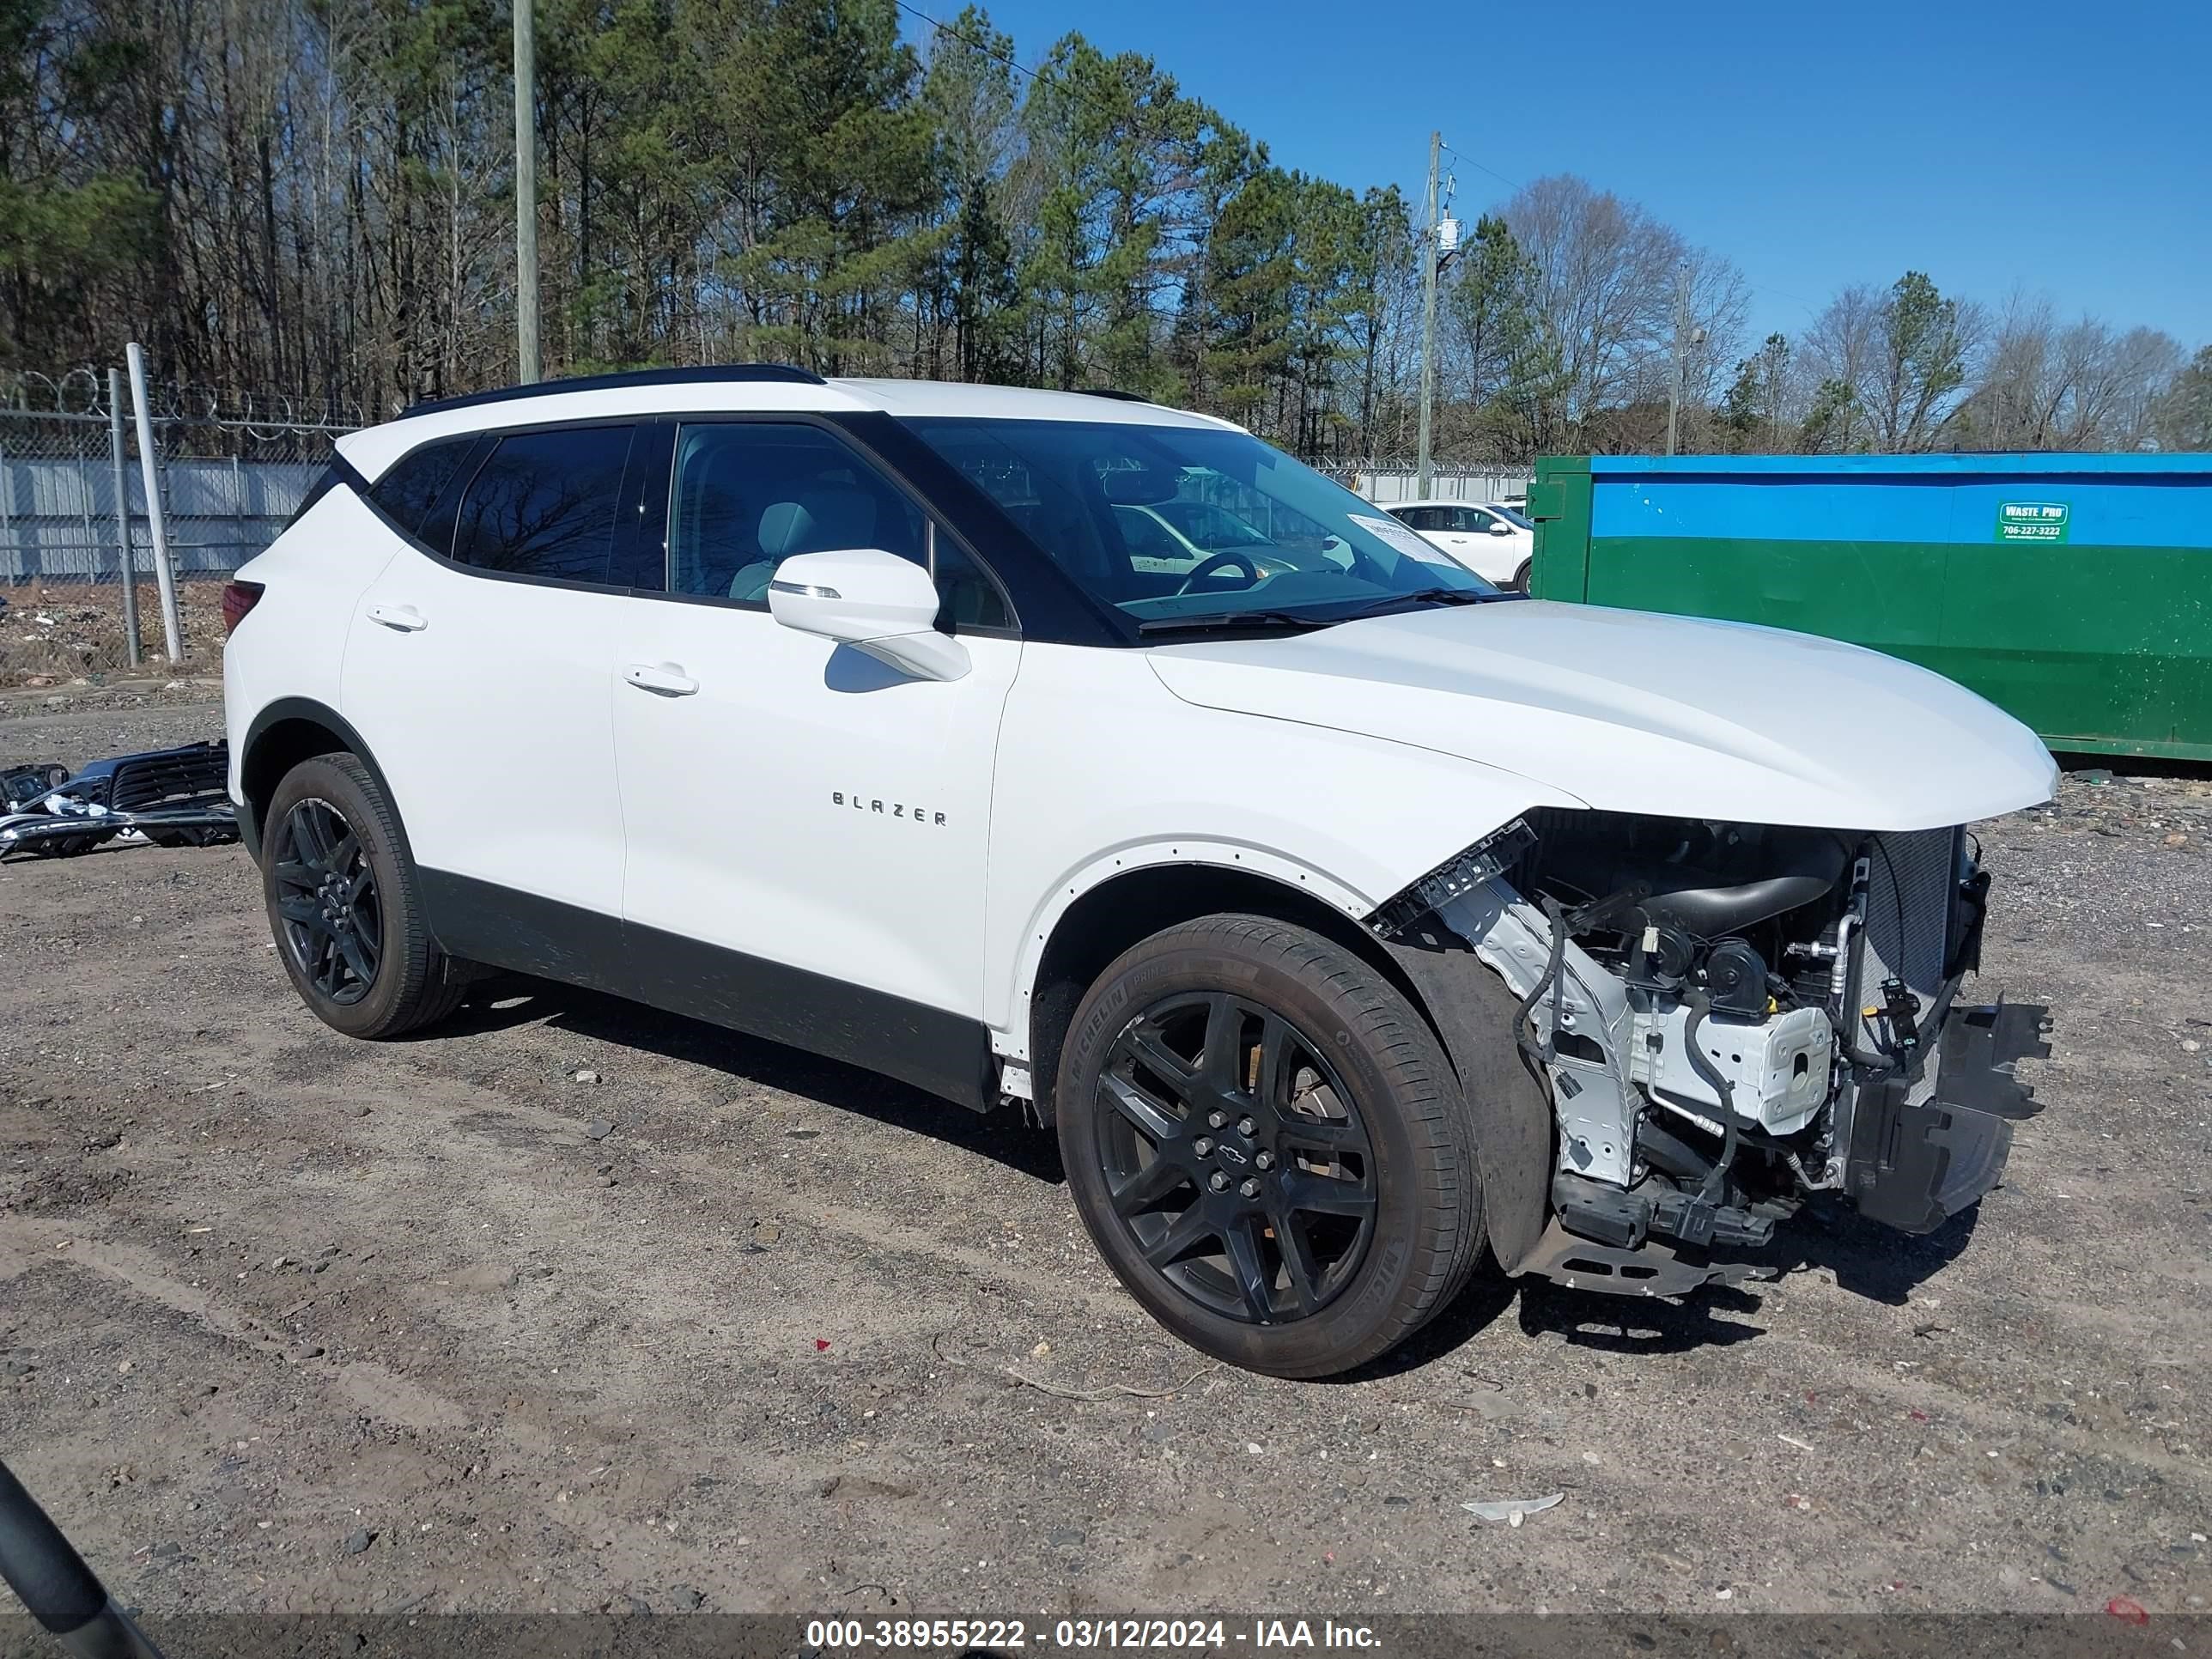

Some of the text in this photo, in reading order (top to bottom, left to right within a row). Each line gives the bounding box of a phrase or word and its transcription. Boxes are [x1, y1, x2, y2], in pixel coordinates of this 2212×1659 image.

[2006, 506, 2063, 517] WASTE PRO
[2003, 526, 2061, 535] 706-227-3222
[832, 792, 946, 827] BLAZER
[1071, 987, 1125, 1080] MICHELIN
